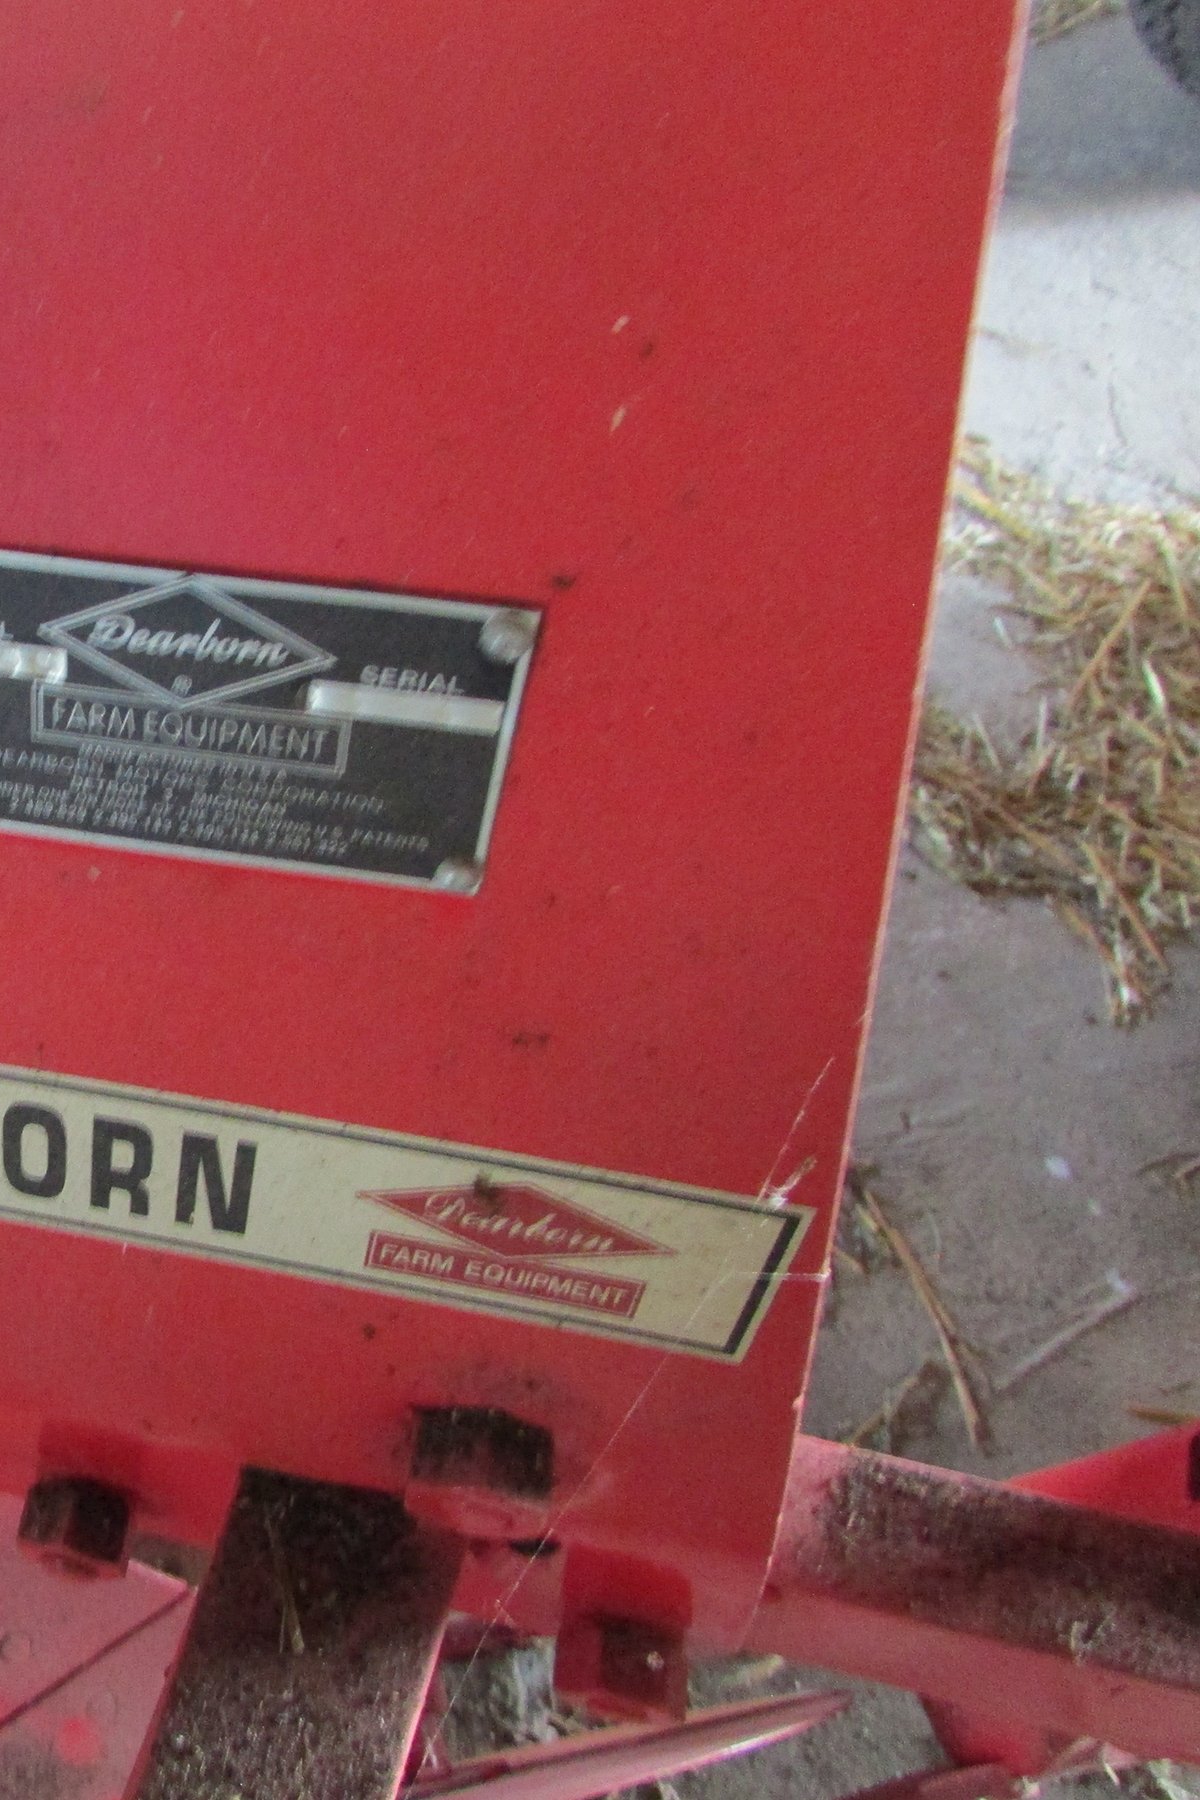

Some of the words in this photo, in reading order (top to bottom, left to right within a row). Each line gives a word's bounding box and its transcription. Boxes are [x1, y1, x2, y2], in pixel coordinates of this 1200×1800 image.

[86, 613, 290, 667] Dearborn
[360, 664, 464, 696] SERIAL
[52, 698, 136, 739] FARM
[143, 710, 330, 761] EQUIPMENT
[220, 777, 384, 813] CORPORATION
[425, 1194, 615, 1253] Dearborn
[380, 1243, 455, 1276] FARM
[464, 1258, 628, 1308] EQUIPMENT
